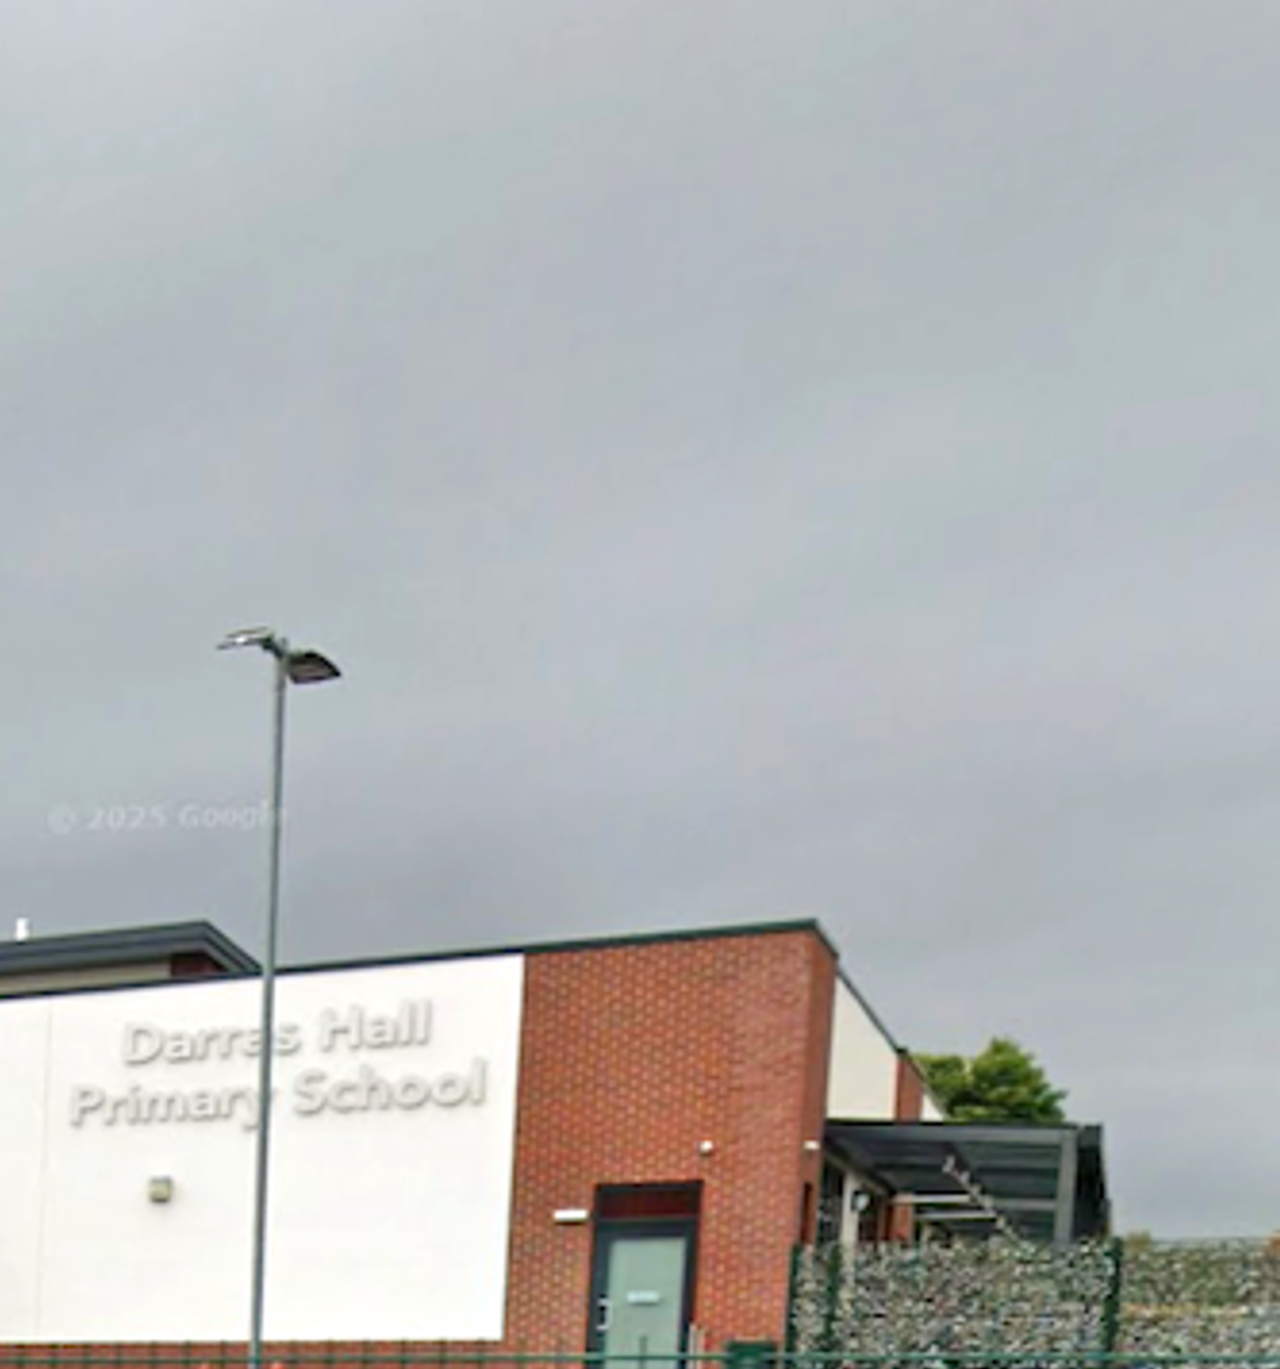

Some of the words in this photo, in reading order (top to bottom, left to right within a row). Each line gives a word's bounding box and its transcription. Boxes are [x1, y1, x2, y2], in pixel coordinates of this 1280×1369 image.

[123, 1019, 303, 1067] Darras
[319, 999, 434, 1054] Hall
[69, 1082, 278, 1133] Primary
[293, 1057, 491, 1117] School
